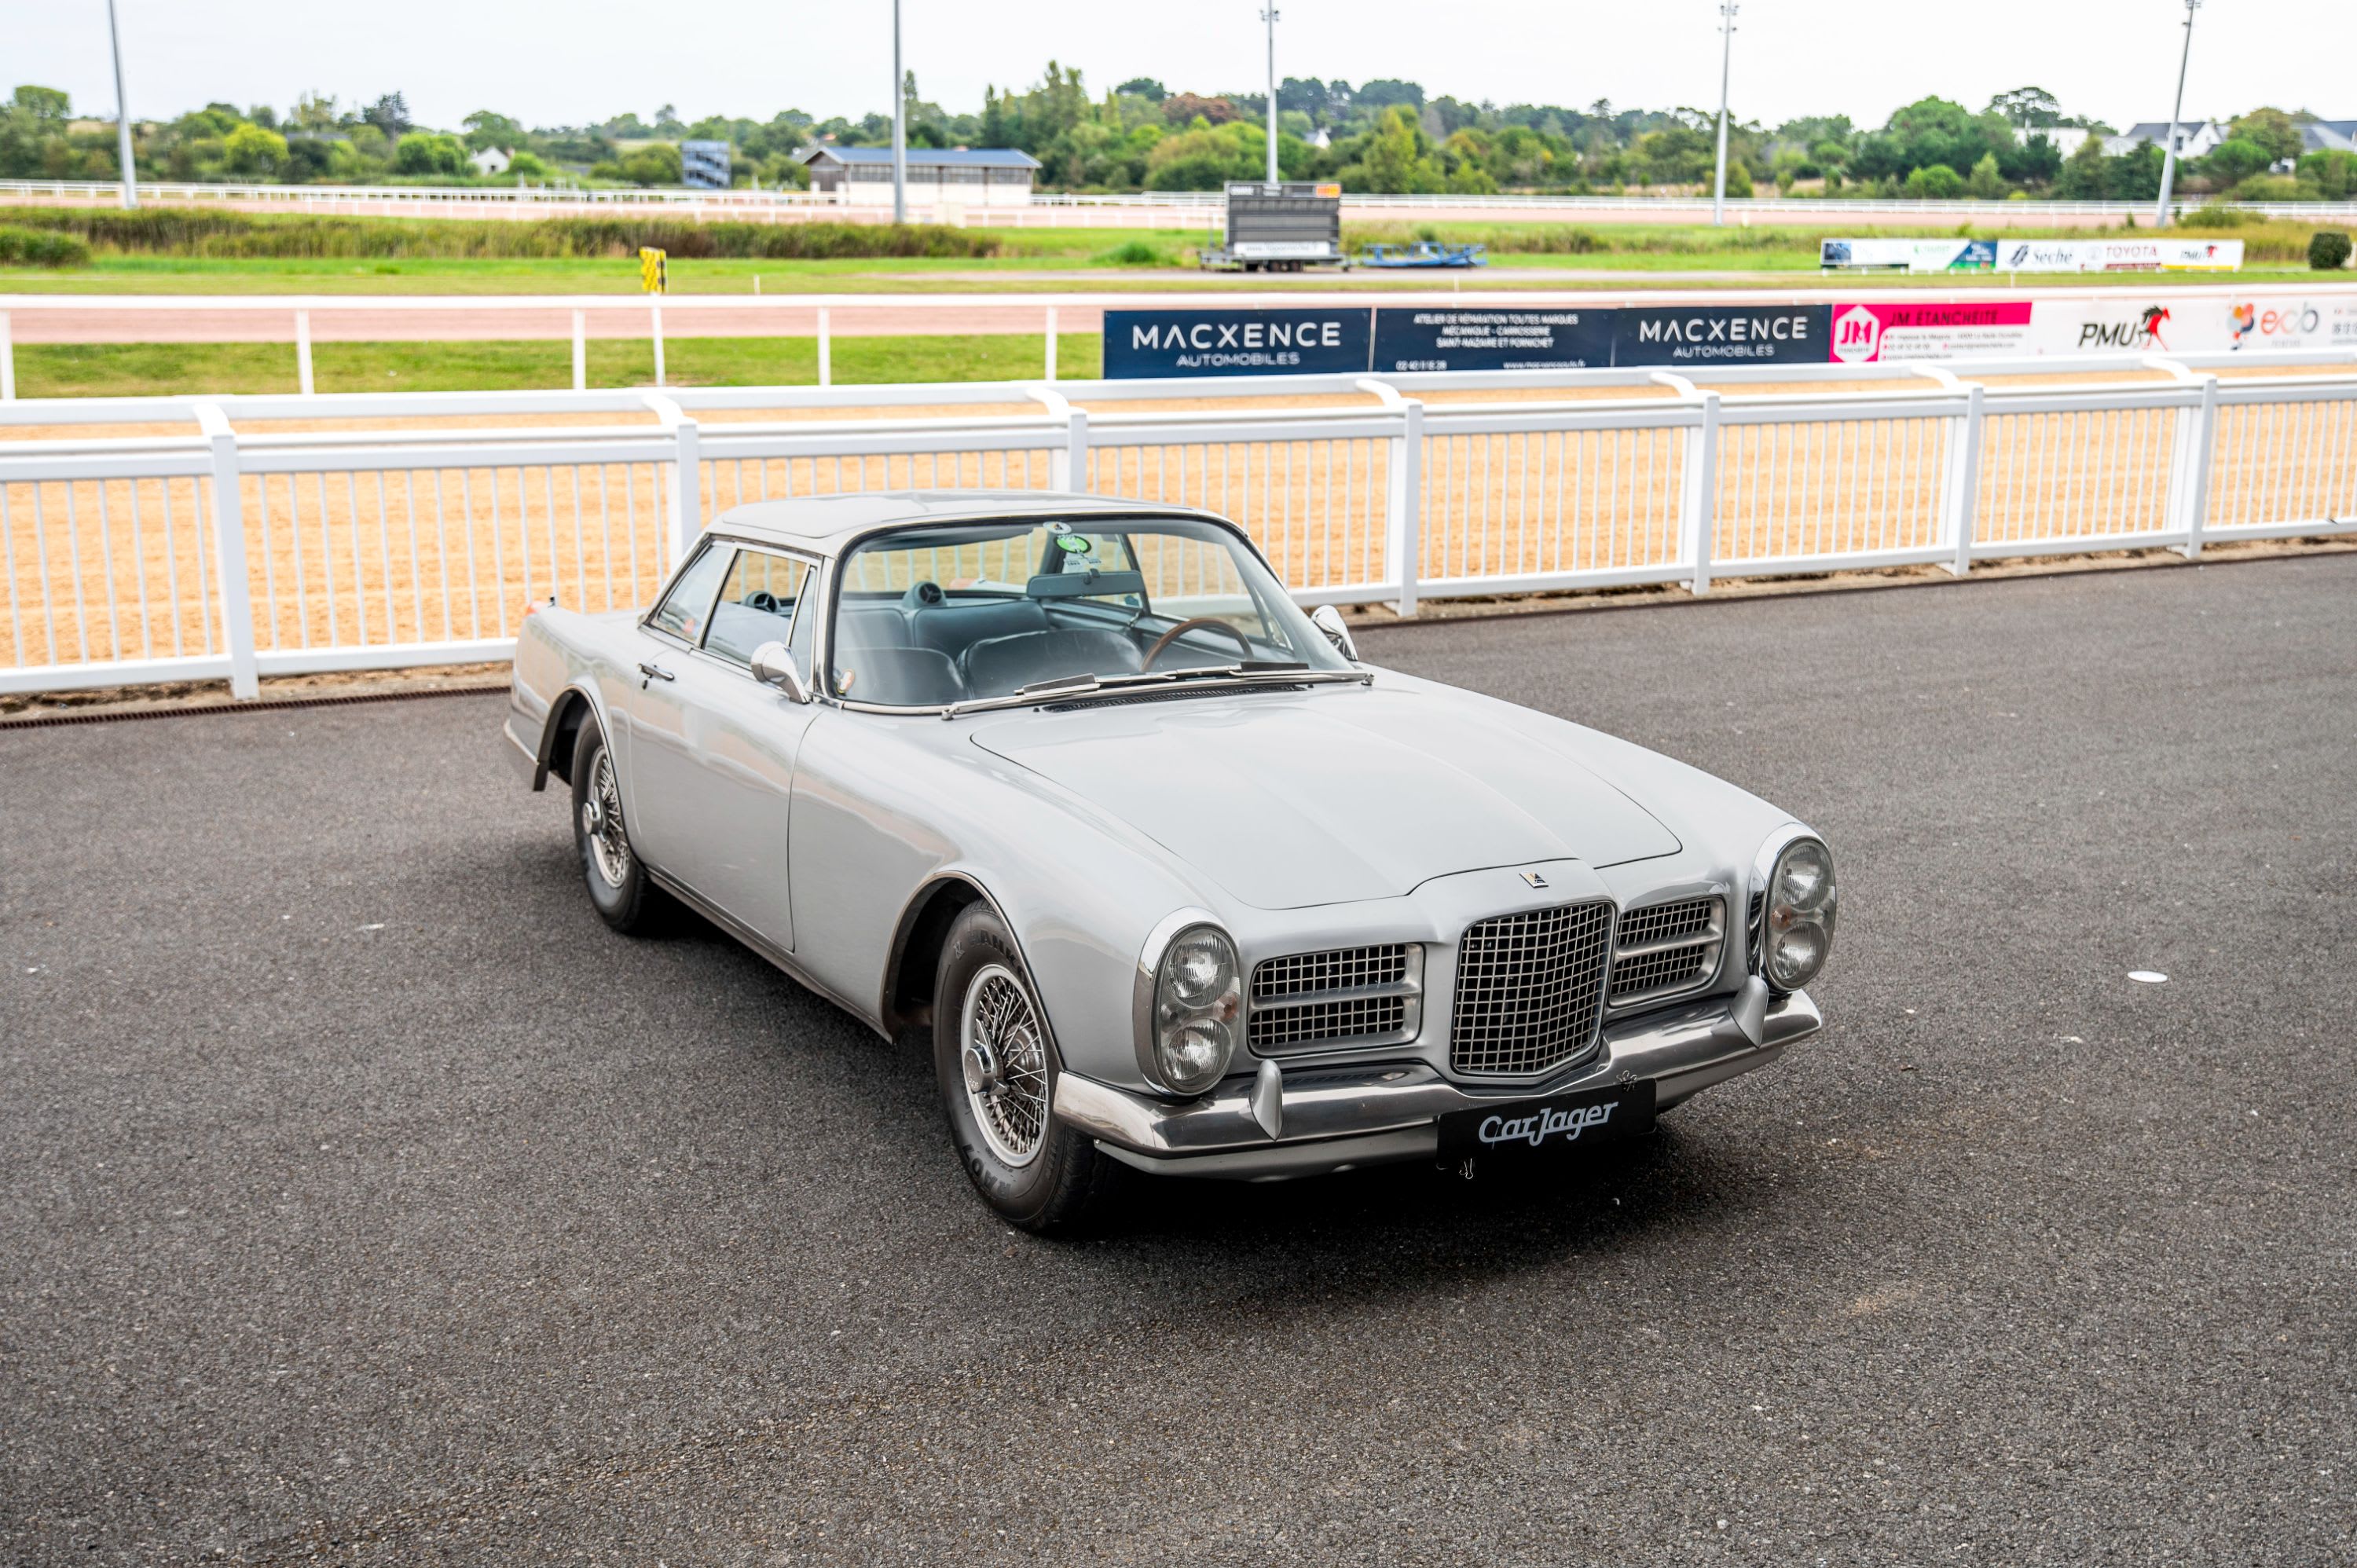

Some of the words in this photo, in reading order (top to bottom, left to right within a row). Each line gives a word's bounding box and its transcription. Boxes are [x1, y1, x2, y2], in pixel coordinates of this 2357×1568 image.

[2106, 245, 2157, 258] TOYOTA
[1413, 313, 1446, 324] ATELIER
[1446, 313, 1458, 324] DE
[1508, 313, 1541, 325] TOUTES
[1541, 313, 1578, 325] MARQUES
[1889, 310, 1910, 327] JM
[1132, 322, 1342, 350] MACXENCE
[1496, 325, 1551, 336] CARROSSERIE
[1639, 316, 1809, 343] MACXENCE
[1840, 321, 1872, 344] JM
[2078, 322, 2136, 346] PMU
[1497, 337, 1508, 348] ET
[1508, 337, 1554, 348] PORNICHET
[1673, 343, 1775, 359] AUTOMOBILES
[1176, 352, 1300, 367] AUTOMOBILES
[1479, 1101, 1619, 1147] CarJager
